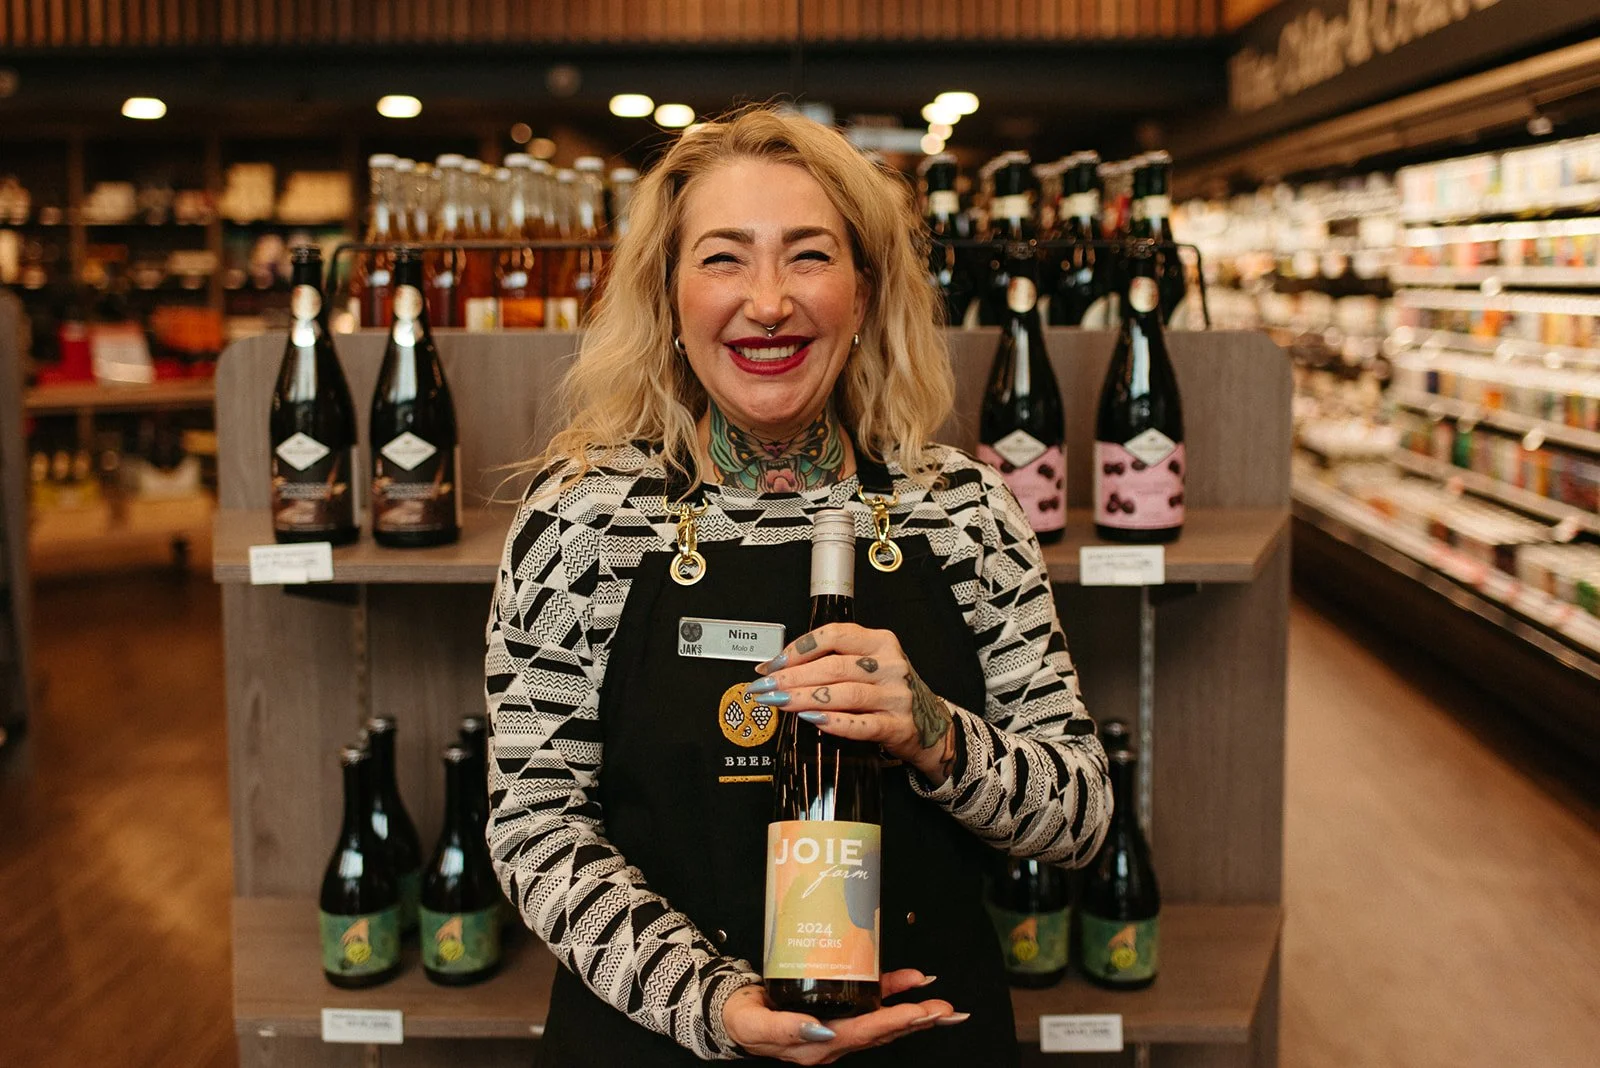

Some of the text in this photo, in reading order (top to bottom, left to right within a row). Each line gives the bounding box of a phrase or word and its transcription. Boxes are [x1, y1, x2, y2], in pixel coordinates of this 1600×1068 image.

[728, 629, 758, 641] Nina
[724, 756, 772, 767] BEER
[775, 837, 863, 866] JOIE
[801, 864, 869, 899] farm
[797, 922, 833, 937] 2024
[787, 938, 842, 949] PINOT GRIS
